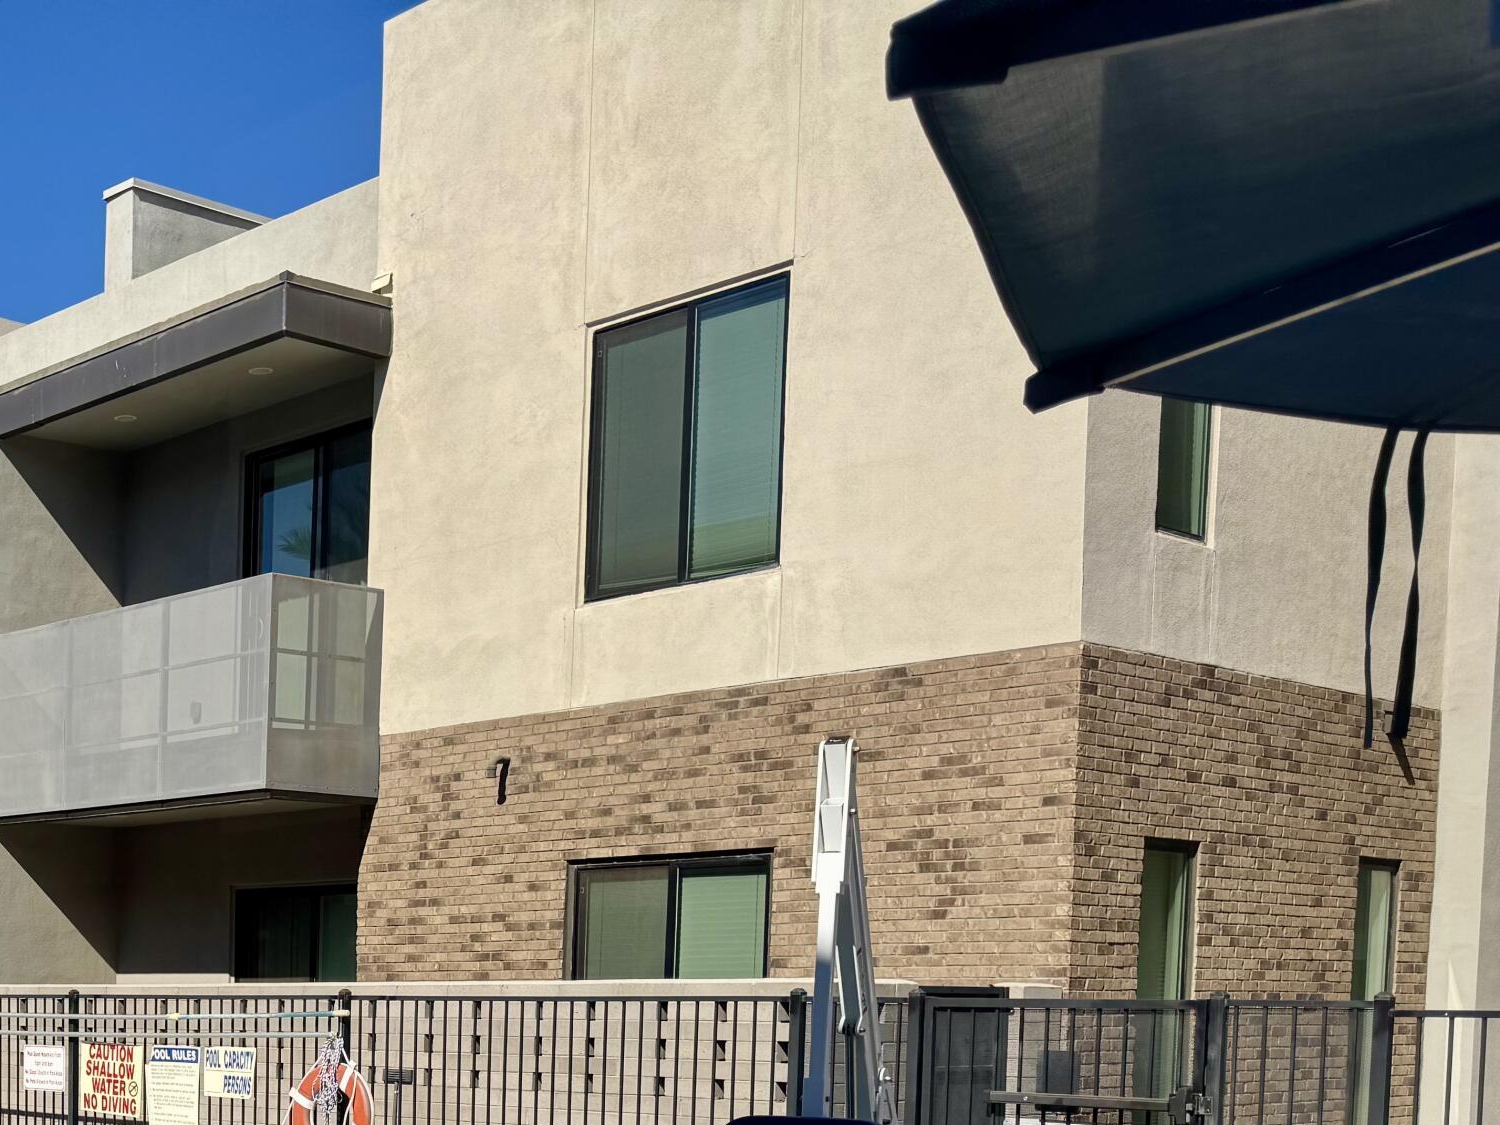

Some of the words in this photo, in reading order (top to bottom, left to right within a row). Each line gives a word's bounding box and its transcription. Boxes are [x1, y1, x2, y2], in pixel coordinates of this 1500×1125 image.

[89, 1043, 134, 1062] CAUTION
[153, 1049, 171, 1060] OOL
[172, 1050, 197, 1061] RULES
[205, 1049, 221, 1069] POOL
[224, 1050, 254, 1070] CAPACITY
[86, 1060, 135, 1080] SHALLOW
[92, 1077, 126, 1096] WATER
[223, 1075, 252, 1096] PERSONS
[83, 1093, 97, 1110] NO
[101, 1095, 137, 1115] DIVING
